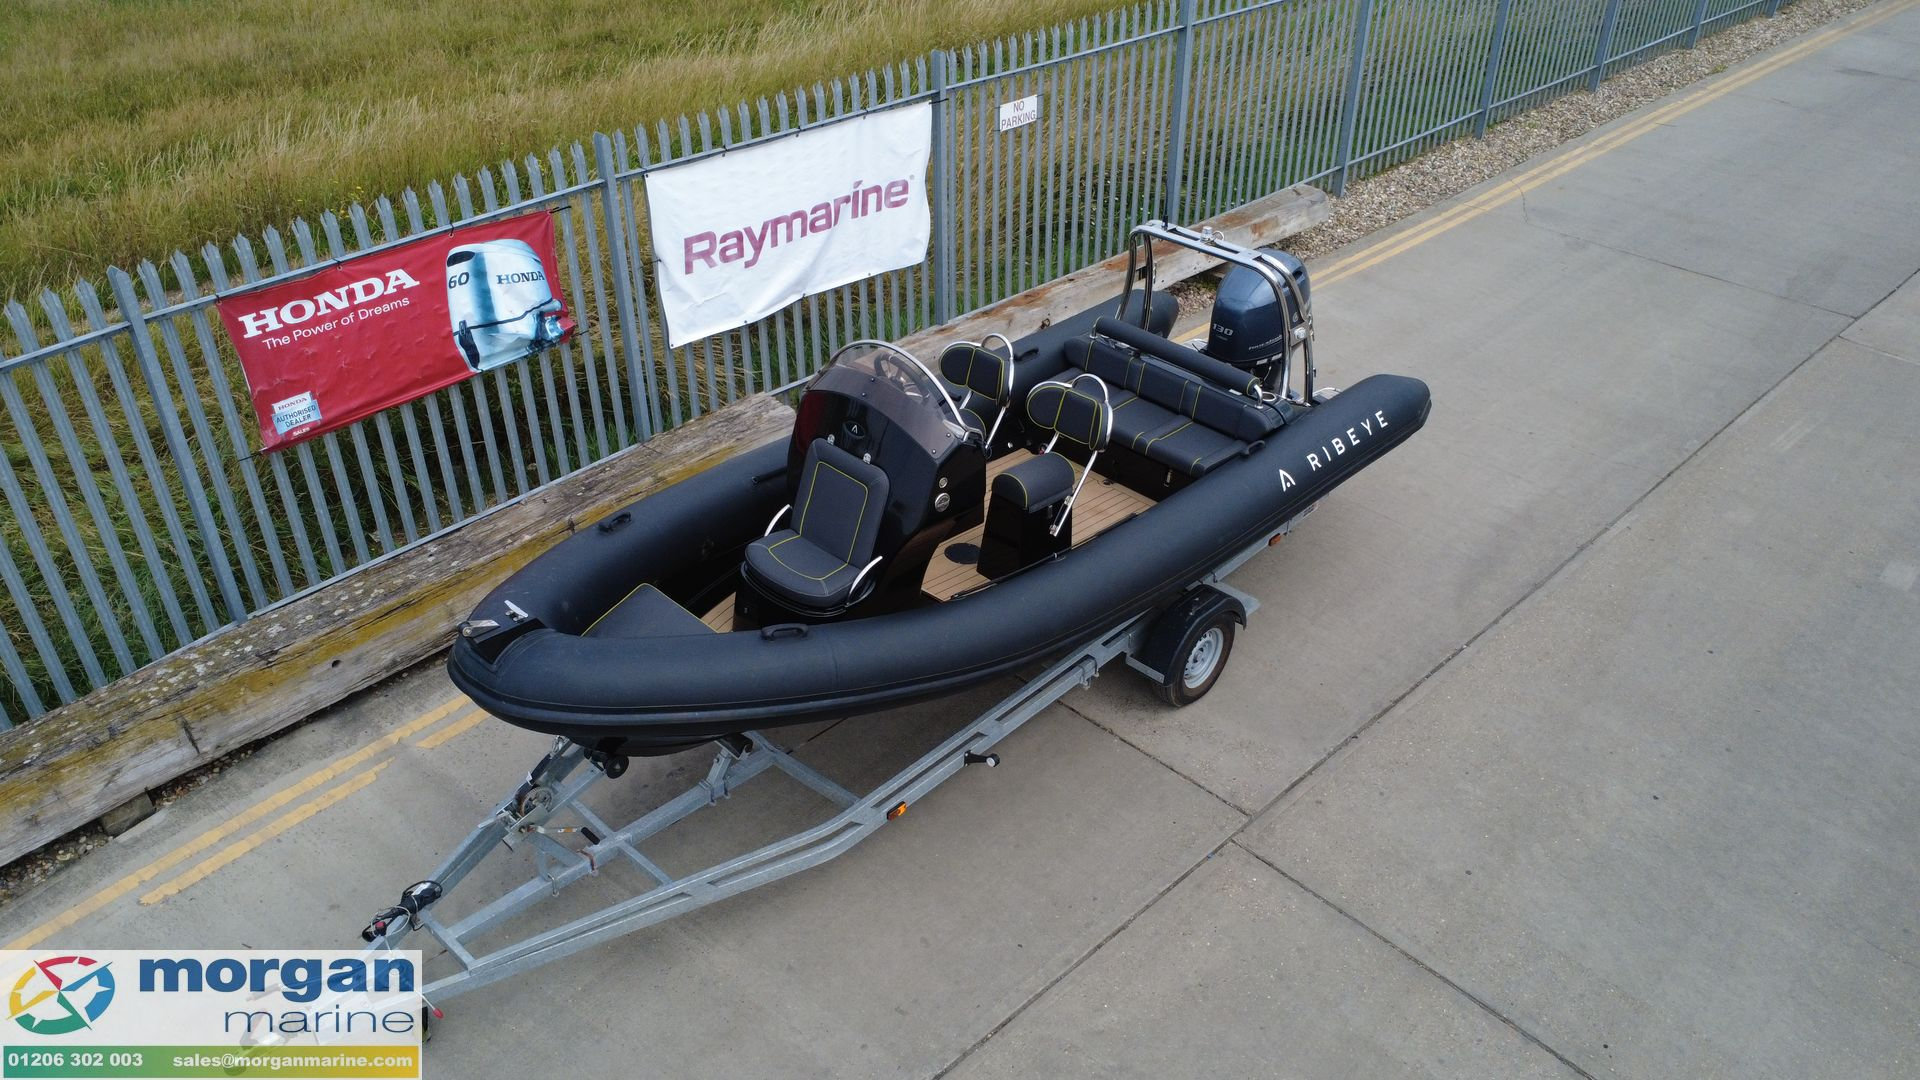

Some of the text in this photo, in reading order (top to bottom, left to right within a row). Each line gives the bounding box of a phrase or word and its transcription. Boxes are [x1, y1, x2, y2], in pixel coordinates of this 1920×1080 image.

[1013, 101, 1025, 113] NO
[1001, 110, 1036, 130] PARKING
[684, 180, 910, 275] Raymarine
[448, 271, 470, 289] 60
[496, 270, 545, 285] HONDA
[238, 268, 420, 339] HONDA
[262, 296, 410, 350] The Power of Dreams
[1212, 323, 1234, 336] 130
[278, 397, 307, 411] HONDA
[276, 404, 317, 423] AUTHORISED
[285, 413, 311, 428] DEALER
[1306, 410, 1388, 471] RIBEYE
